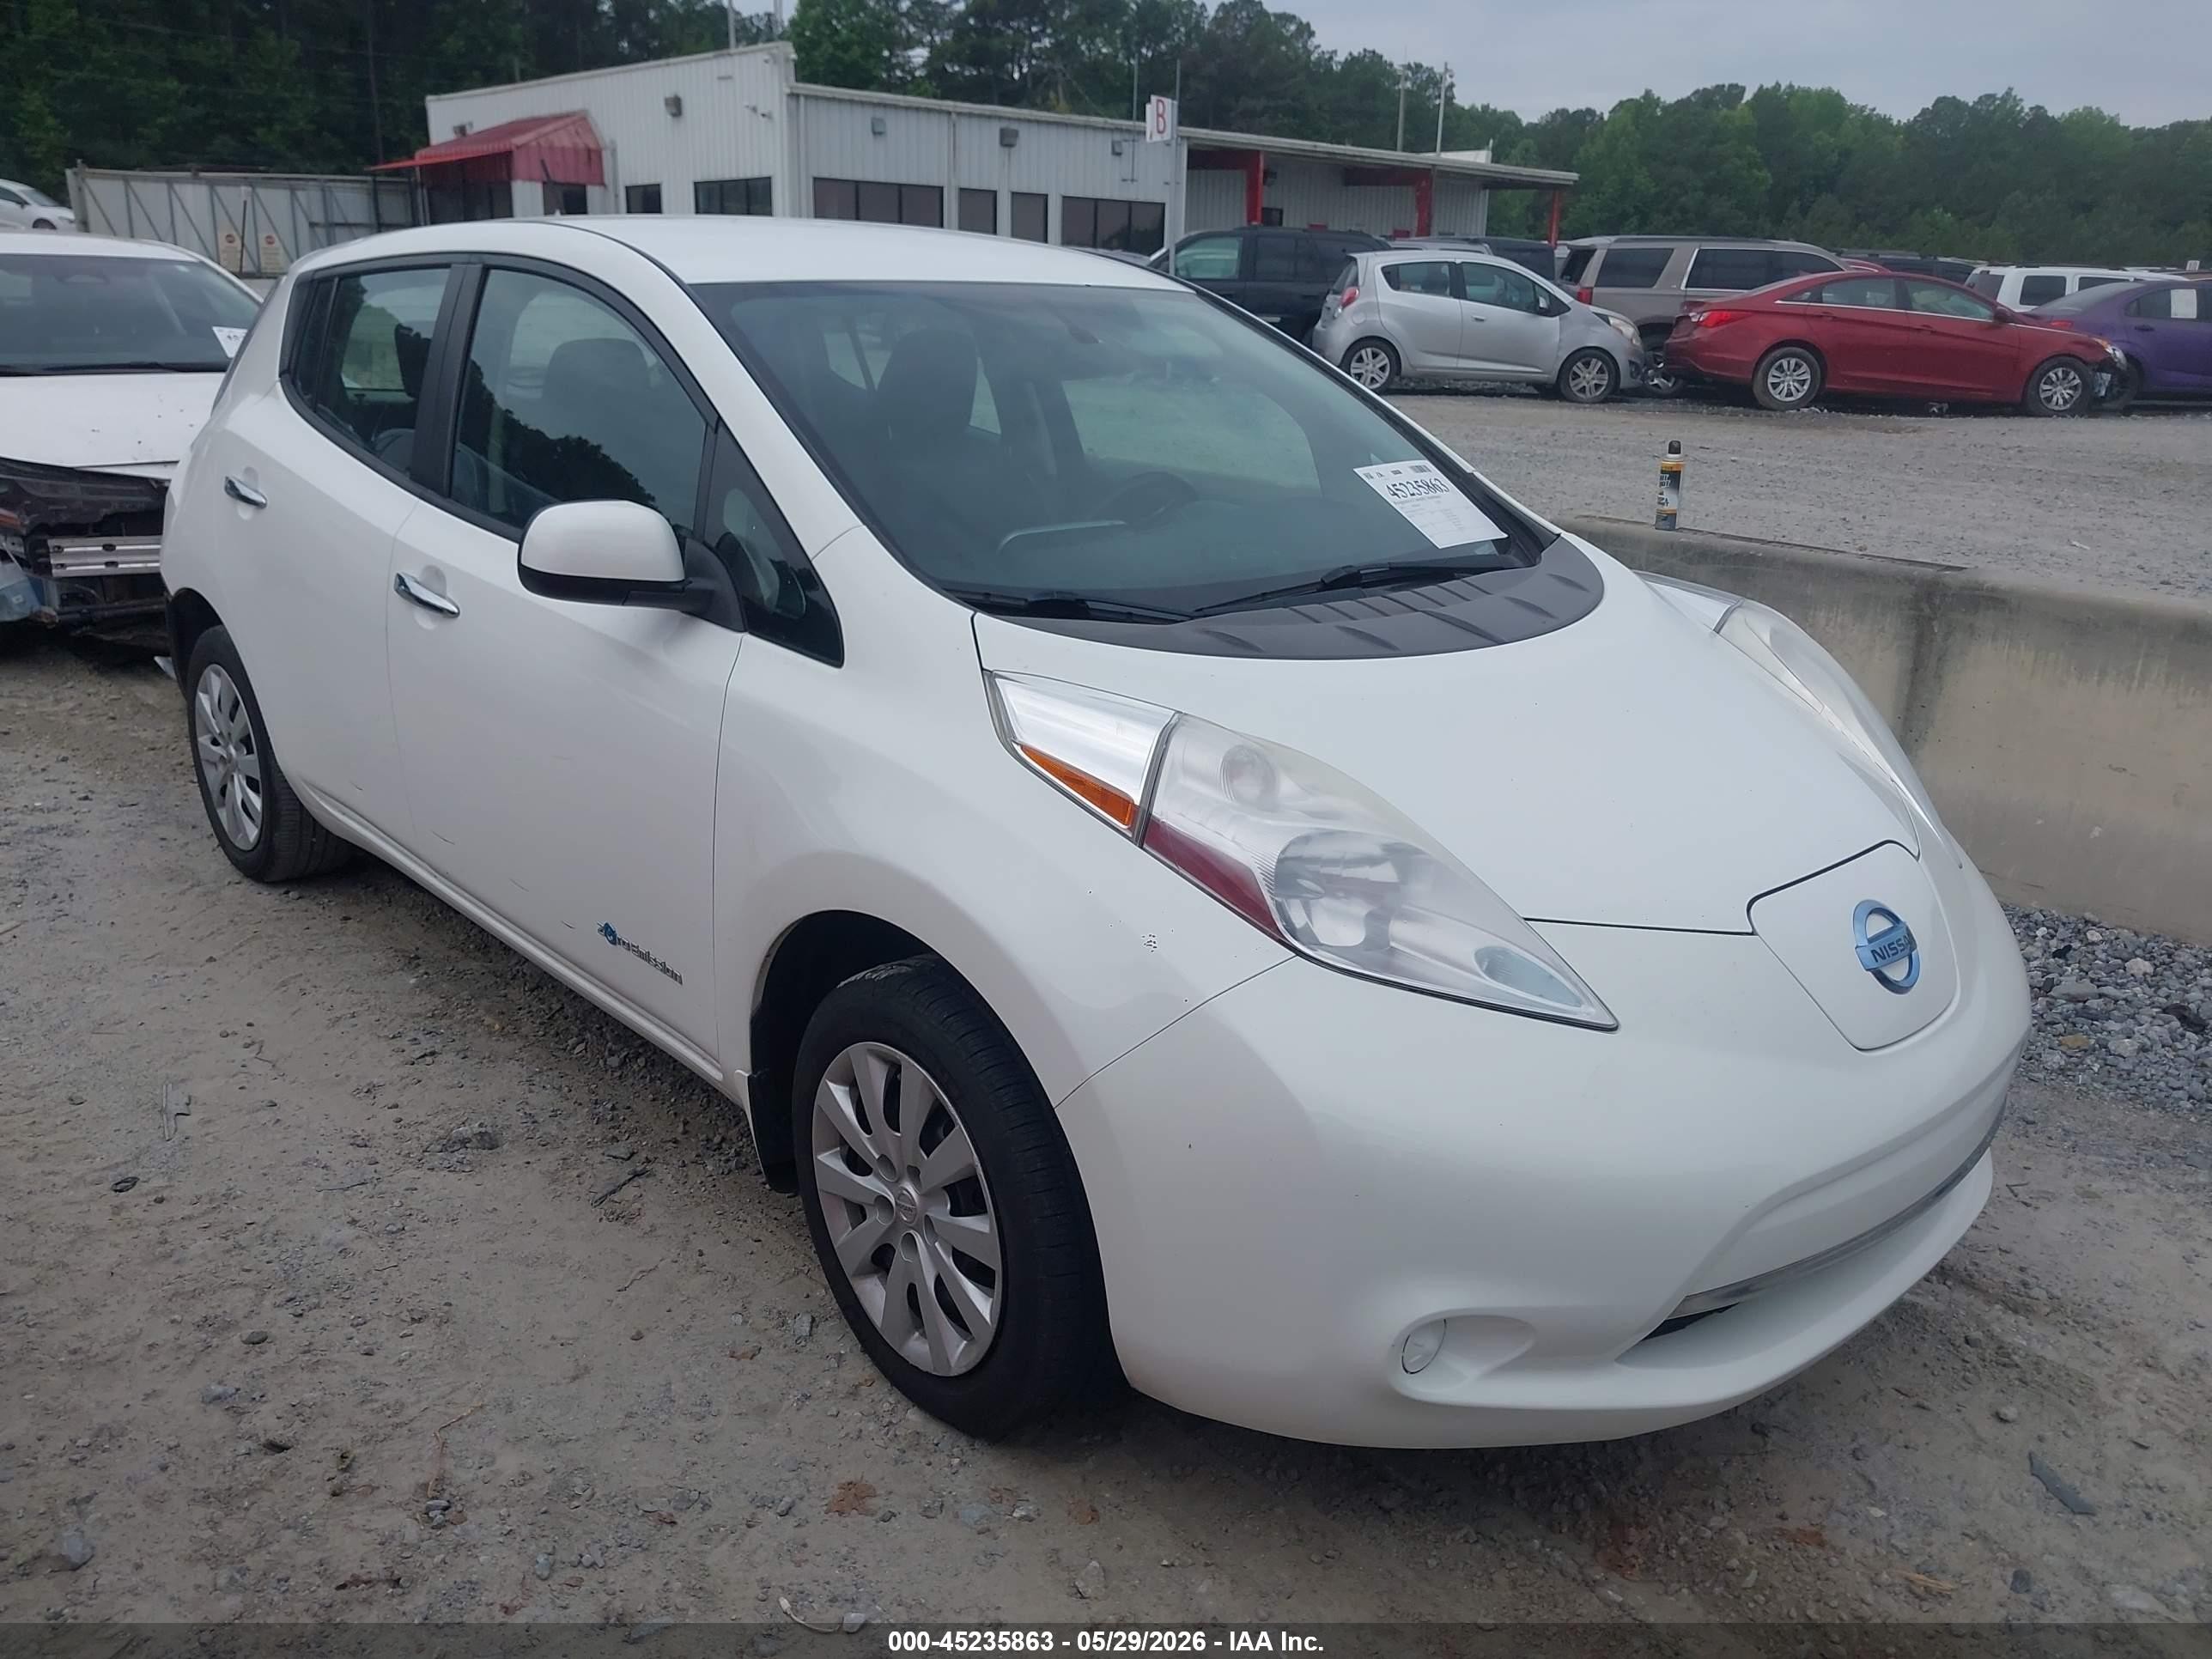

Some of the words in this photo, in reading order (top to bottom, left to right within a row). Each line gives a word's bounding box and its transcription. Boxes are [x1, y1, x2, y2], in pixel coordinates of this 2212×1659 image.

[1156, 99, 1166, 134] B
[1386, 478, 1449, 499] 45235863
[1871, 934, 1911, 963] NISSA
